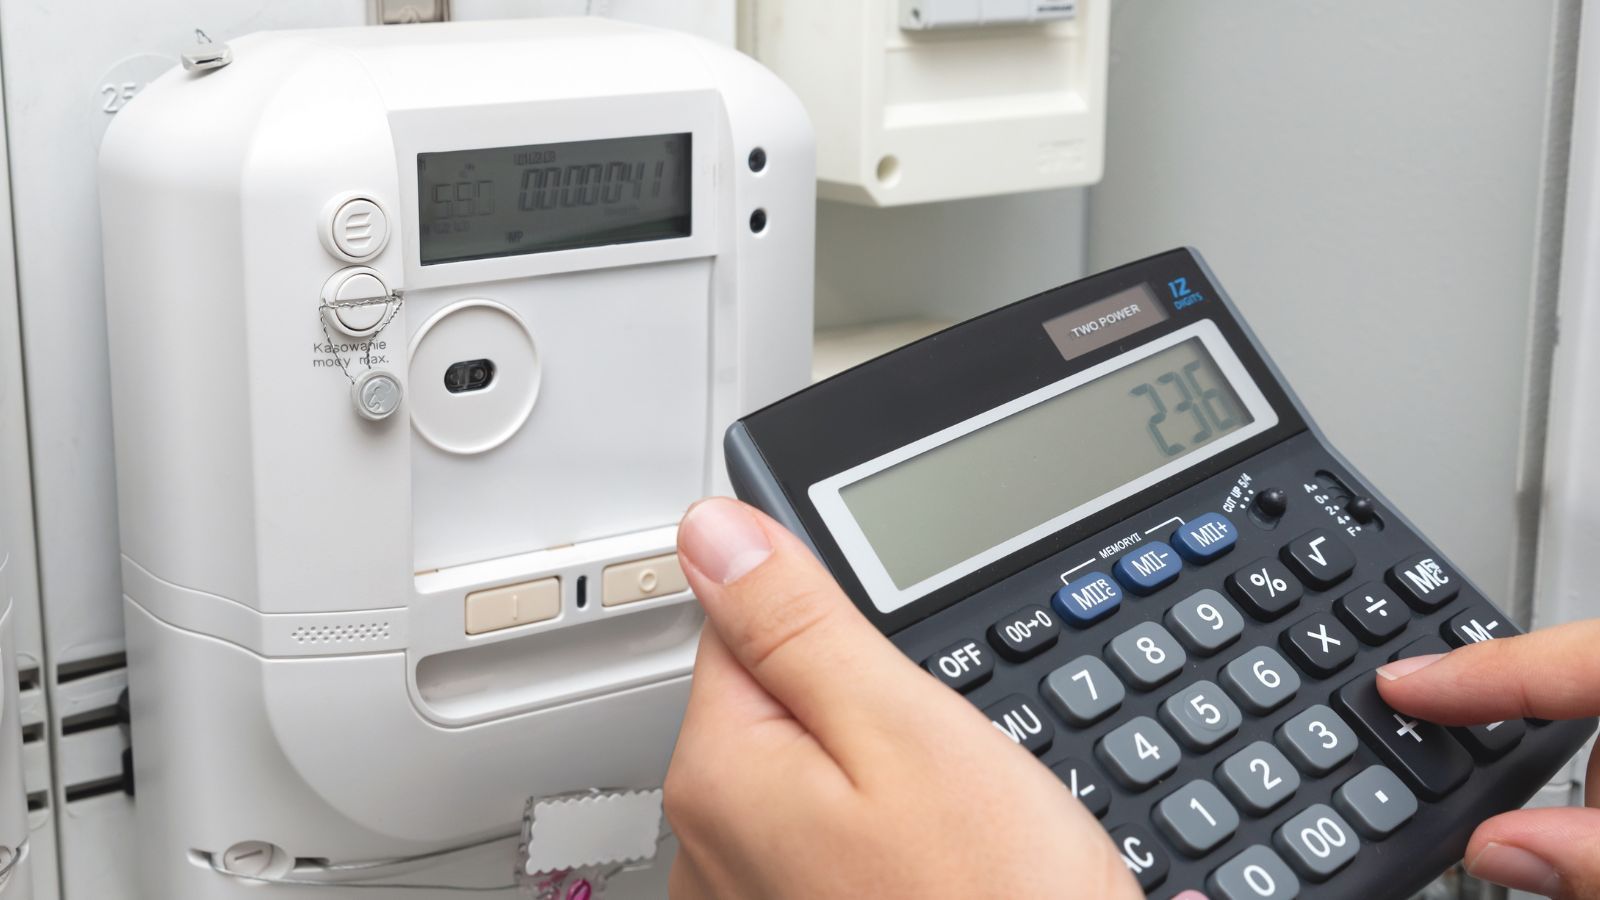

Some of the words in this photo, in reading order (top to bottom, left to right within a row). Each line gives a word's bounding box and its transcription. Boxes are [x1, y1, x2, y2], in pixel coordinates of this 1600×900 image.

[1167, 277, 1191, 298] 12
[1174, 292, 1204, 310] DIGITS
[1071, 321, 1099, 338] TWO
[1097, 303, 1142, 327] POWER
[313, 340, 387, 354] Kasowanie
[313, 356, 351, 369] mocy
[359, 354, 390, 366] max.
[1129, 360, 1242, 457] 236
[1222, 496, 1236, 513] CUT
[1230, 486, 1242, 499] UP
[1237, 472, 1253, 488] 5/4
[1250, 567, 1288, 598] %
[1196, 603, 1224, 630] 9
[938, 642, 982, 678] OFF
[1136, 636, 1166, 665] 8
[1072, 669, 1099, 701] 7
[1253, 660, 1281, 688] 6
[992, 704, 1042, 744] MU
[1190, 694, 1221, 725] 5
[1134, 732, 1161, 760] 4
[1308, 721, 1338, 749] 3
[1249, 758, 1283, 790] 2
[1190, 798, 1217, 827] 1
[1300, 817, 1347, 858] 00
[1243, 864, 1276, 897] 0
